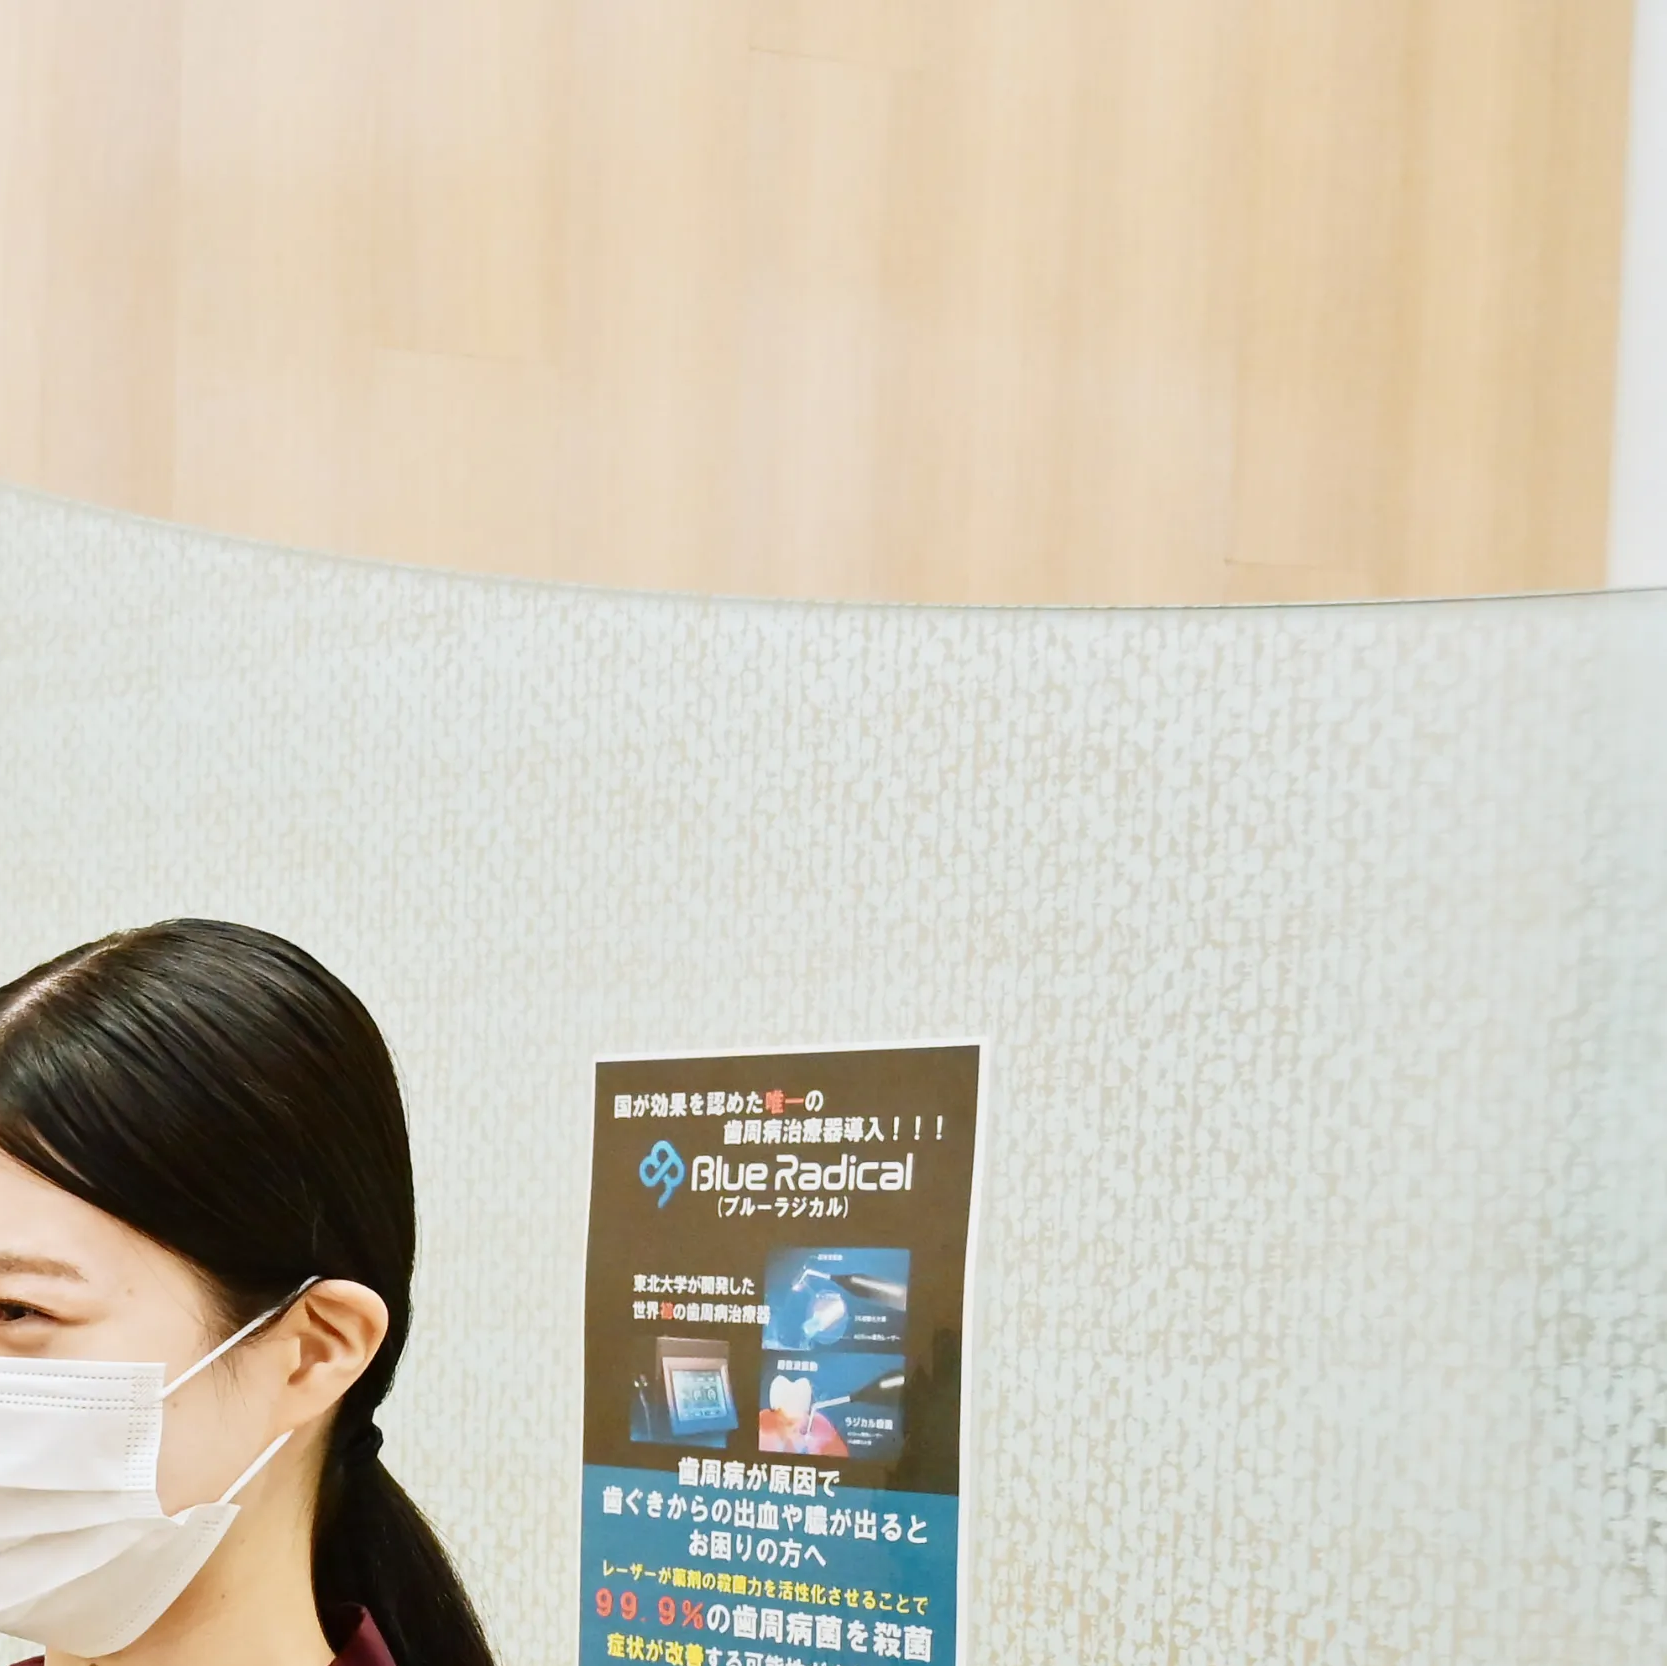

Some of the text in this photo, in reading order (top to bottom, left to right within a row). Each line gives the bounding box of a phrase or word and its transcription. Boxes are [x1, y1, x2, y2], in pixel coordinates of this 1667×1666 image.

[614, 1089, 824, 1118] 国が効果を認めた唯一の
[691, 1152, 914, 1191] Blue Radical
[717, 1196, 849, 1218] (ブルーラジカル)
[633, 1274, 755, 1296] 東北大学が開発した
[678, 1456, 840, 1498] 歯周病が原因で
[602, 1485, 928, 1545] 歯ぐきからの出血や膿が出ると
[688, 1530, 827, 1569] お困りの方へ
[603, 1559, 929, 1615] レーザーが薬剤の殺菌力を活性化させることで
